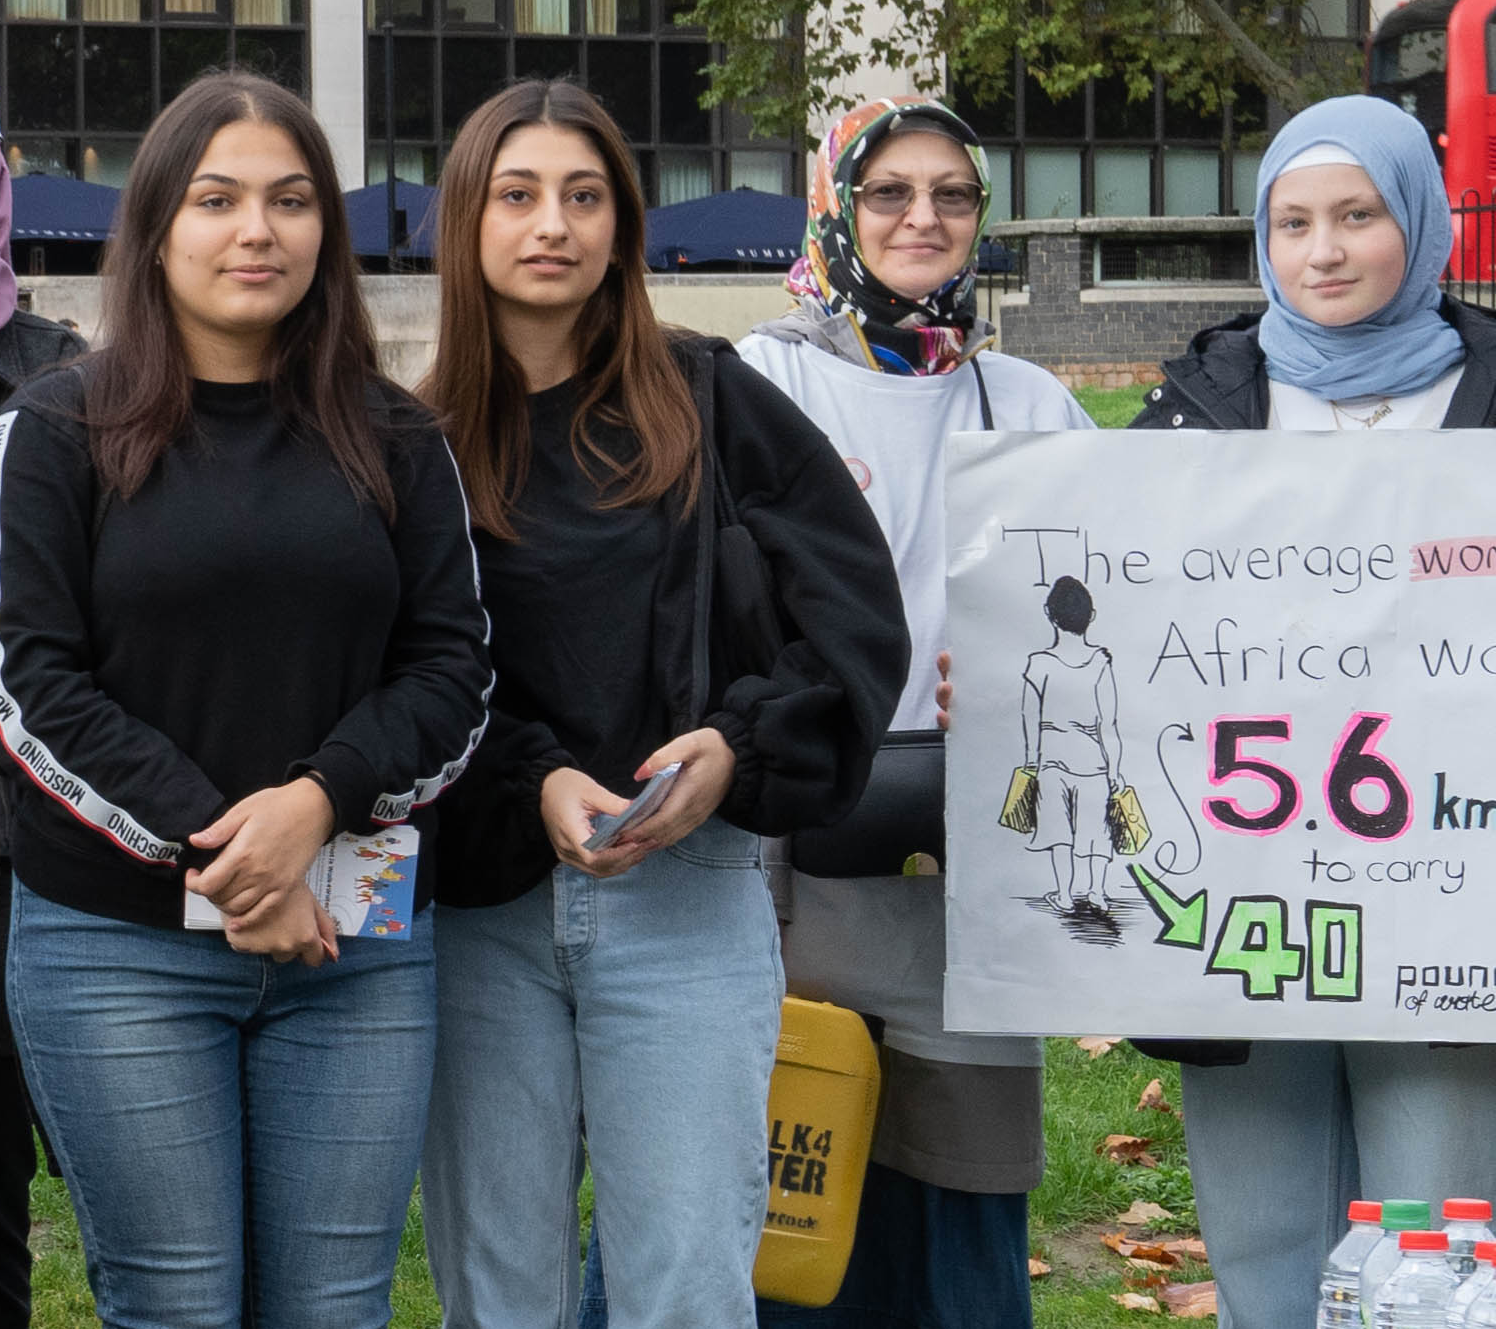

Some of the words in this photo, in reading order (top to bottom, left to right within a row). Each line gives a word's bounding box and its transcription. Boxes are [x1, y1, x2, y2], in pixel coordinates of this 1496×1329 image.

[1002, 525, 1155, 588] The
[1181, 543, 1397, 595] average
[1147, 617, 1373, 689] Africa
[16, 739, 87, 808] MOSCHINO
[1202, 711, 1414, 843] 5.6
[106, 812, 183, 861] MOSCHINO
[1304, 848, 1356, 885] to
[1365, 857, 1467, 895] carry
[1204, 894, 1365, 1002] 40
[1396, 965, 1496, 1009] poun
[1404, 990, 1428, 1016] of
[770, 1119, 832, 1159] LK4
